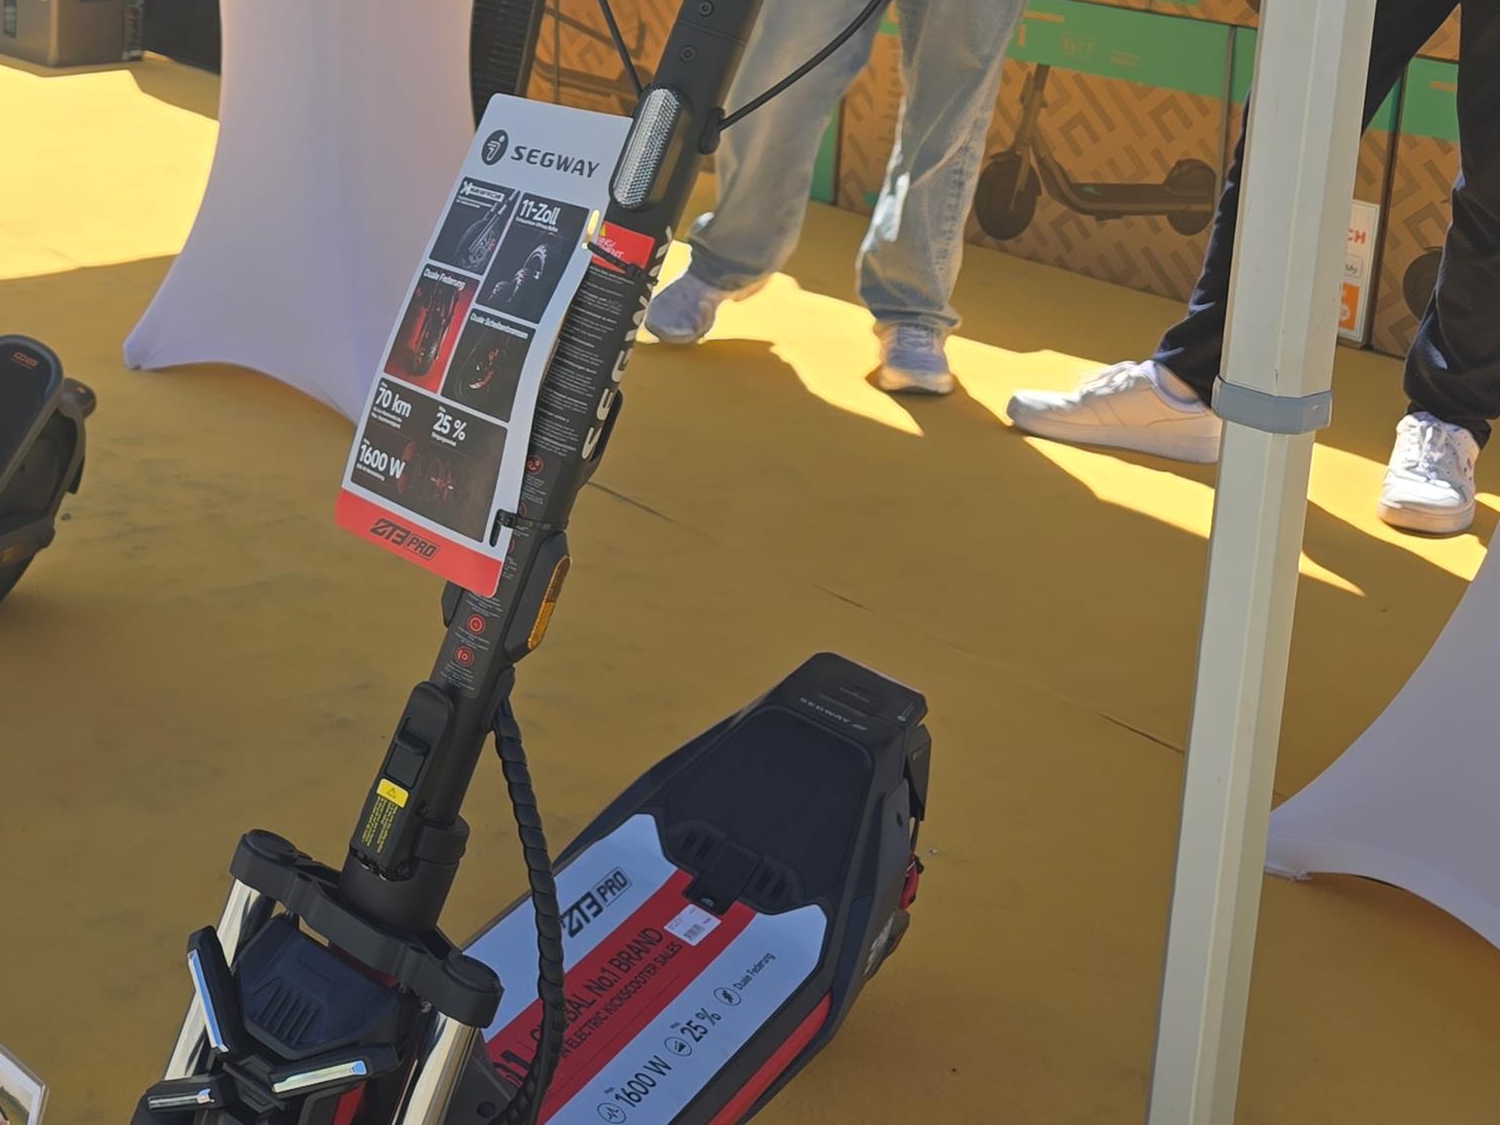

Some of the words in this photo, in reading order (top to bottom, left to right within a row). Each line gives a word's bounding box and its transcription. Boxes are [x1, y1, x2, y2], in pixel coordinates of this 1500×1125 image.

[510, 145, 601, 179] SEGWAY
[519, 199, 561, 226] 11-Zoll
[375, 386, 393, 408] 70
[391, 393, 412, 417] km
[432, 412, 452, 435] 25
[452, 419, 467, 441] %
[359, 444, 389, 472] 1600
[389, 456, 406, 480] W
[370, 518, 411, 547] ZT3
[407, 536, 437, 558] PRO
[596, 869, 629, 905] PRO
[582, 967, 616, 998] No.1
[609, 926, 665, 974] BRAND
[566, 1005, 609, 1049] ELECTRIC
[604, 962, 659, 1016] KICKSCOOTER
[654, 941, 683, 967] SALES
[680, 1019, 709, 1043] 25
[695, 1007, 722, 1026] %
[613, 1072, 657, 1109] 1600
[643, 1054, 673, 1077] W
